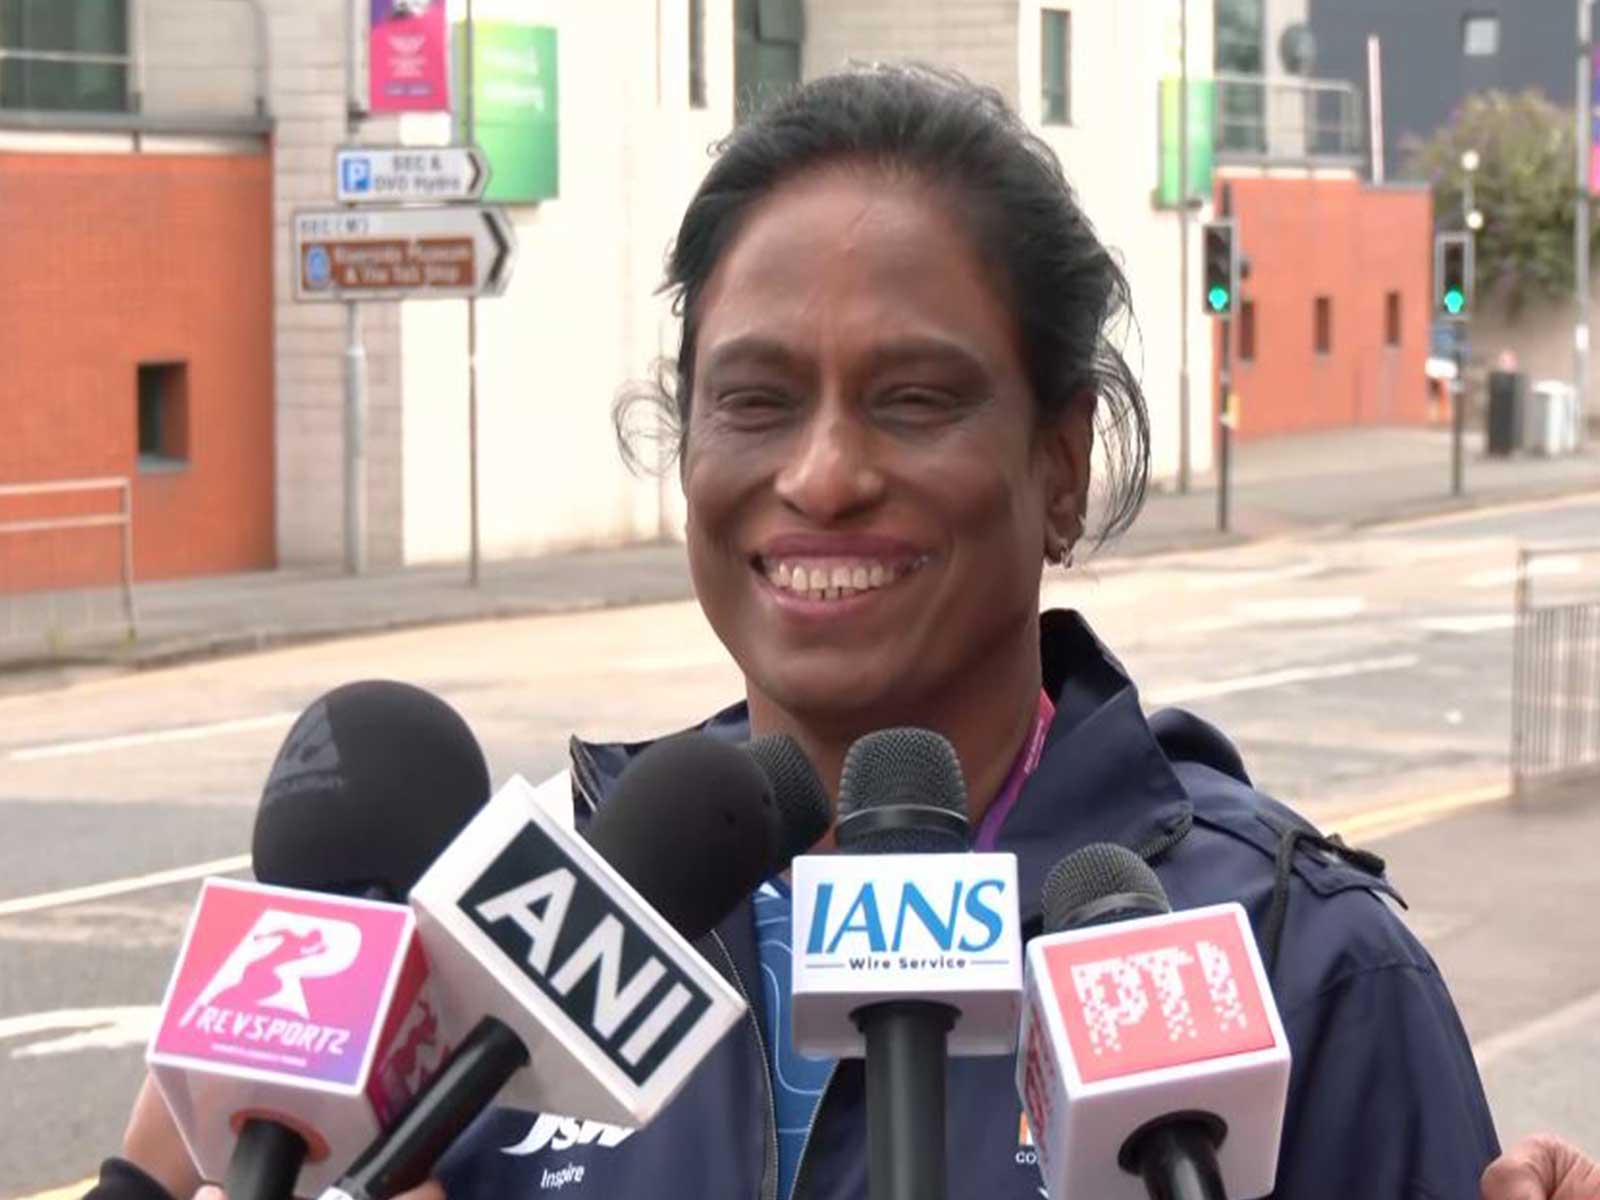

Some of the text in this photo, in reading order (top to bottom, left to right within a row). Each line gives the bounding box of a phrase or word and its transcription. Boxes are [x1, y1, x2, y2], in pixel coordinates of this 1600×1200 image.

[806, 879, 1006, 955] IANS
[474, 867, 694, 1068] ANI
[848, 955, 966, 970] Wire Service
[197, 1004, 351, 1056] REVSPORTZ
[1070, 940, 1248, 1056] PTI
[540, 1162, 585, 1190] Inspire
